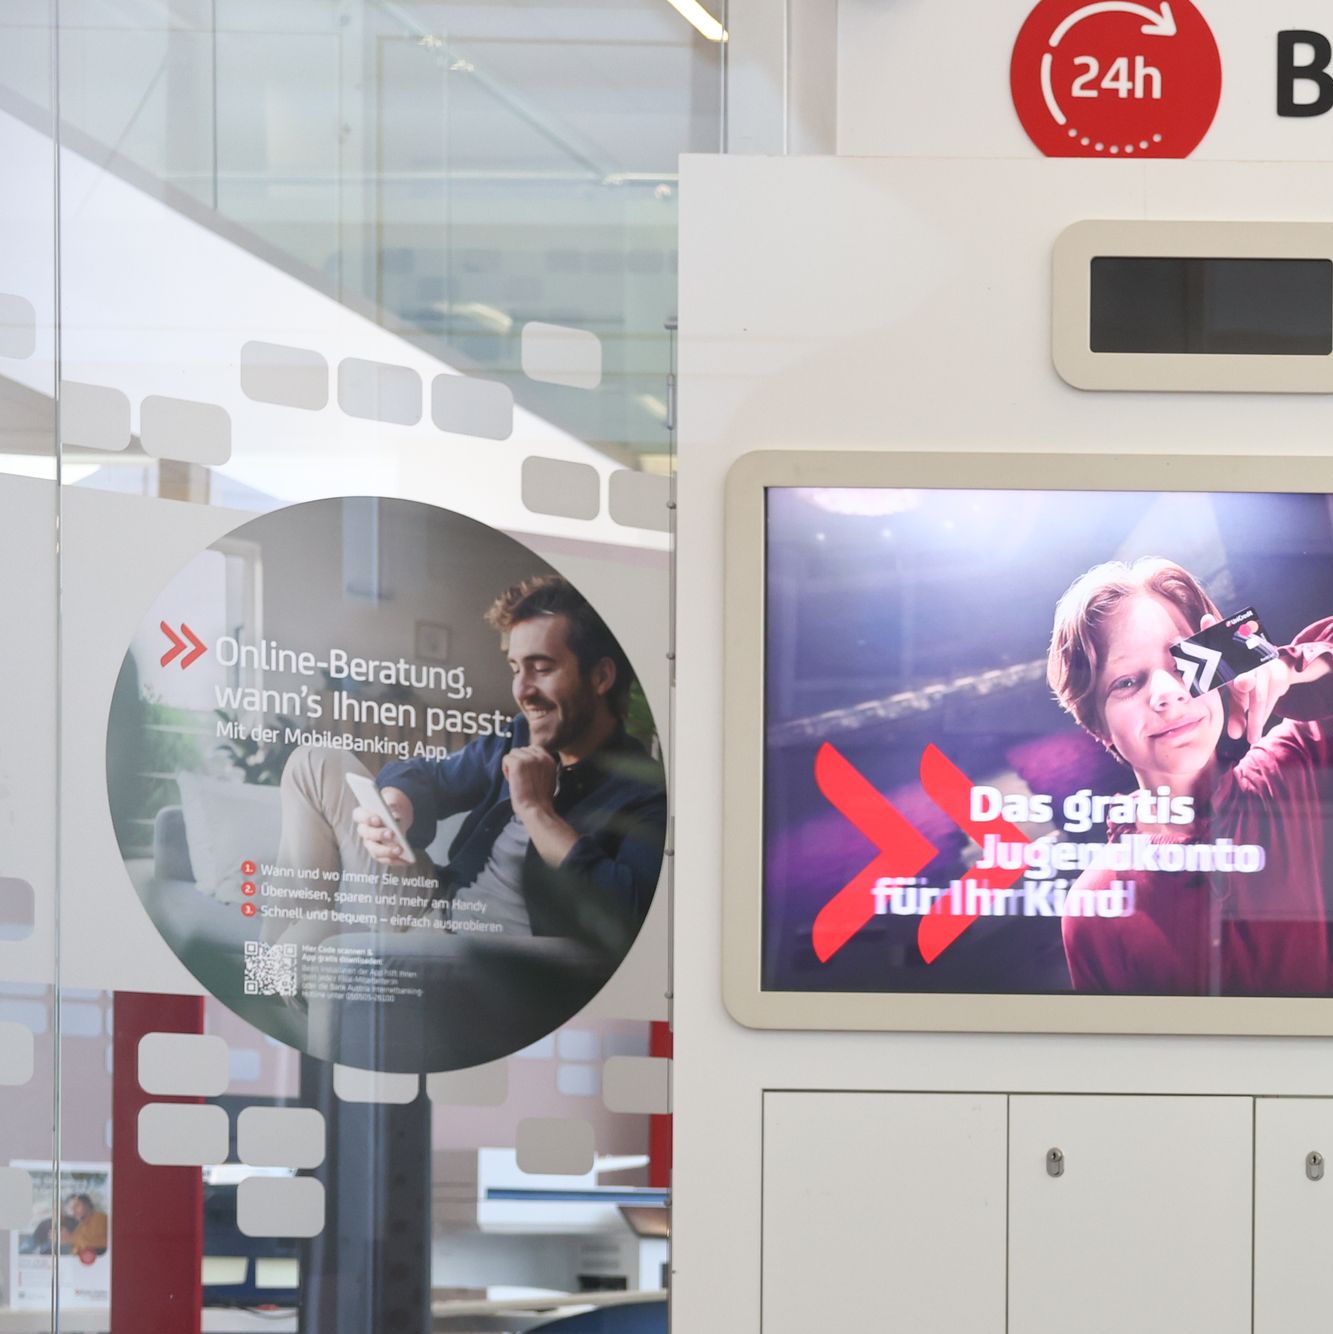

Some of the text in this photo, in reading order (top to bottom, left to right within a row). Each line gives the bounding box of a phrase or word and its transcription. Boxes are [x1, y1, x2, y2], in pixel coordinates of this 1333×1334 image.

[1070, 54, 1162, 100] 24h
[215, 636, 473, 699] Online-Beratung,
[214, 685, 513, 738] wann's Ihnen passt:
[216, 721, 451, 763] Mit der MobileBanking App.
[970, 785, 1195, 833] Das gratis
[260, 863, 294, 878] Wann
[297, 867, 319, 881] und
[322, 870, 340, 882] wo
[342, 870, 379, 885] immer
[381, 873, 399, 887] Sie
[401, 874, 439, 888] wollen
[976, 833, 1266, 879] Jugendkonto
[260, 882, 331, 903] Überweisen,
[334, 890, 372, 905] sparen
[374, 892, 396, 906] und
[399, 893, 429, 908] mehr
[431, 898, 449, 910] am
[452, 898, 487, 914] Handy
[871, 876, 940, 916] für
[949, 879, 1012, 916] Ihr
[260, 905, 304, 920] Schnell
[307, 907, 328, 921] und
[331, 909, 377, 926] bequem
[390, 915, 430, 929] einfach
[433, 917, 502, 933] ausprobieren
